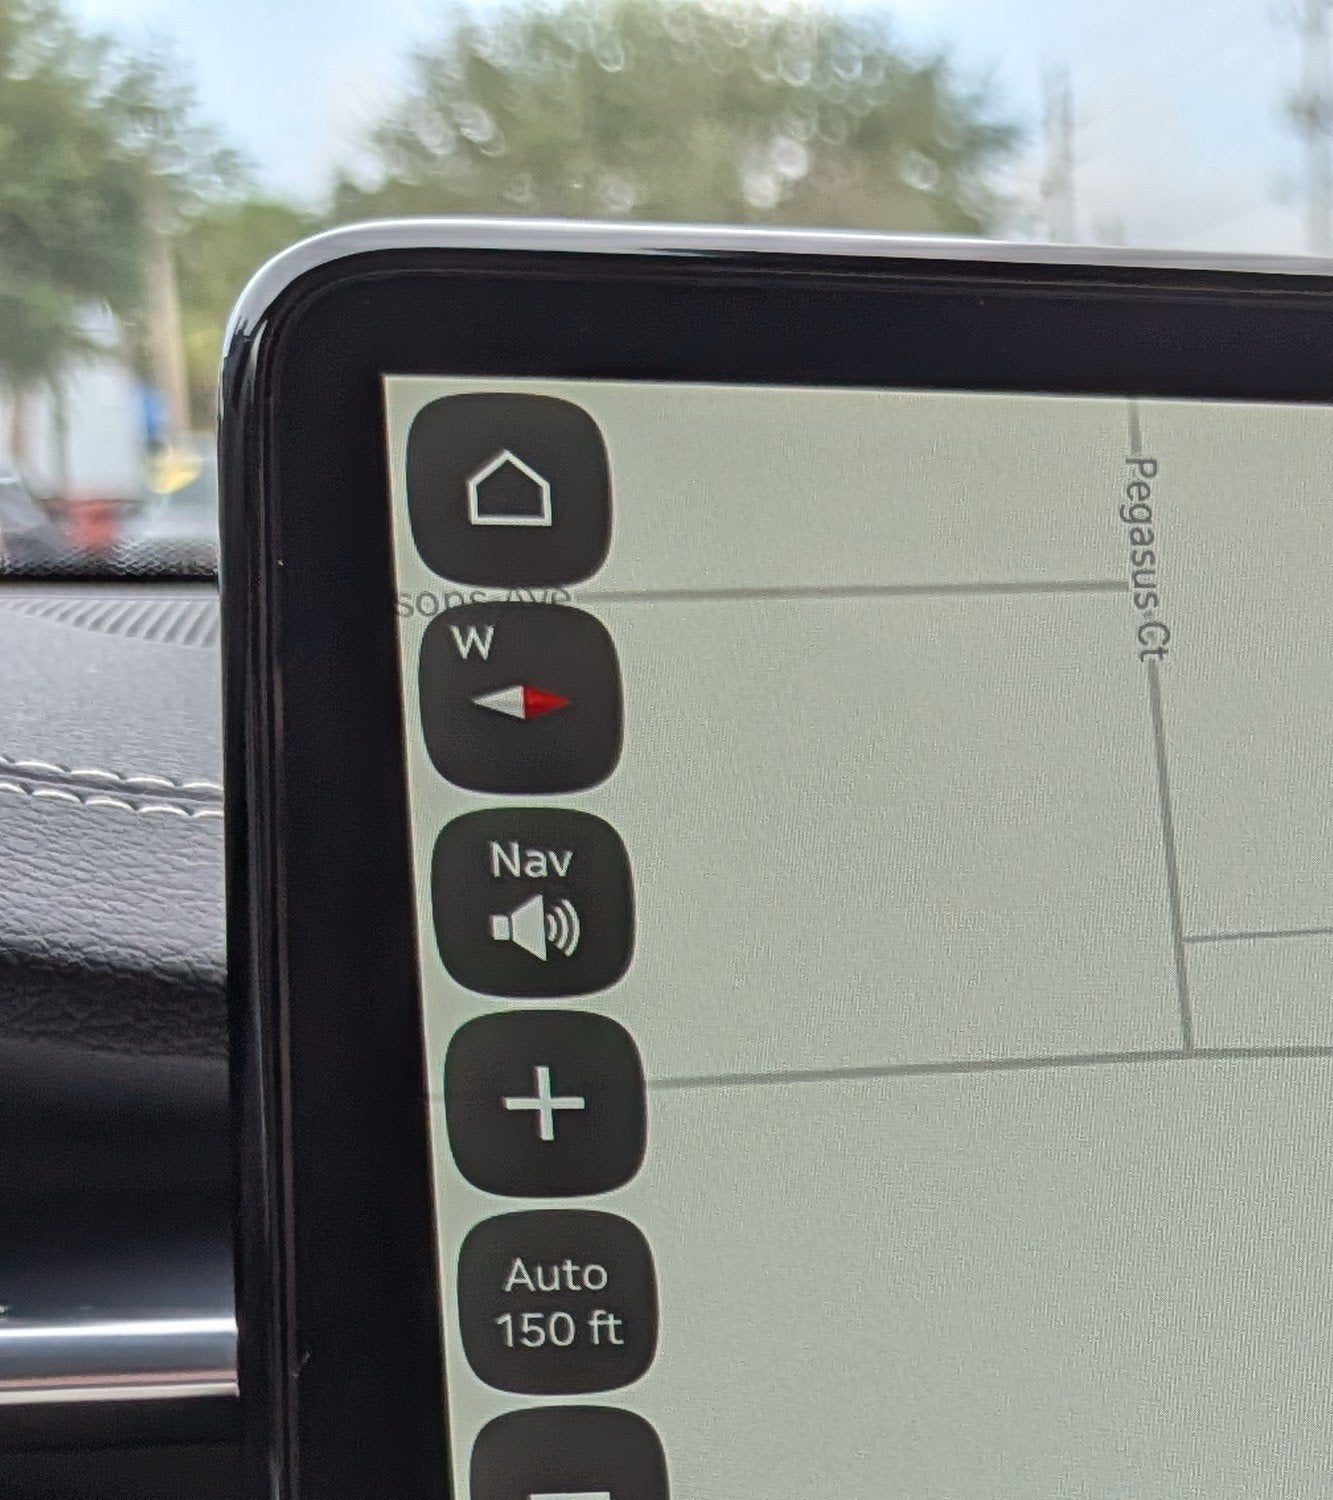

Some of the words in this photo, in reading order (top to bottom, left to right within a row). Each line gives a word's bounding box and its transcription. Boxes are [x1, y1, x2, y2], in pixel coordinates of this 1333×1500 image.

[1119, 457, 1160, 610] Pegasus
[450, 624, 495, 661] W
[1137, 620, 1171, 663] Ct
[491, 840, 574, 878] Nav
[503, 1257, 609, 1292] Auto
[496, 1310, 576, 1348] 150
[587, 1309, 626, 1345] ft
